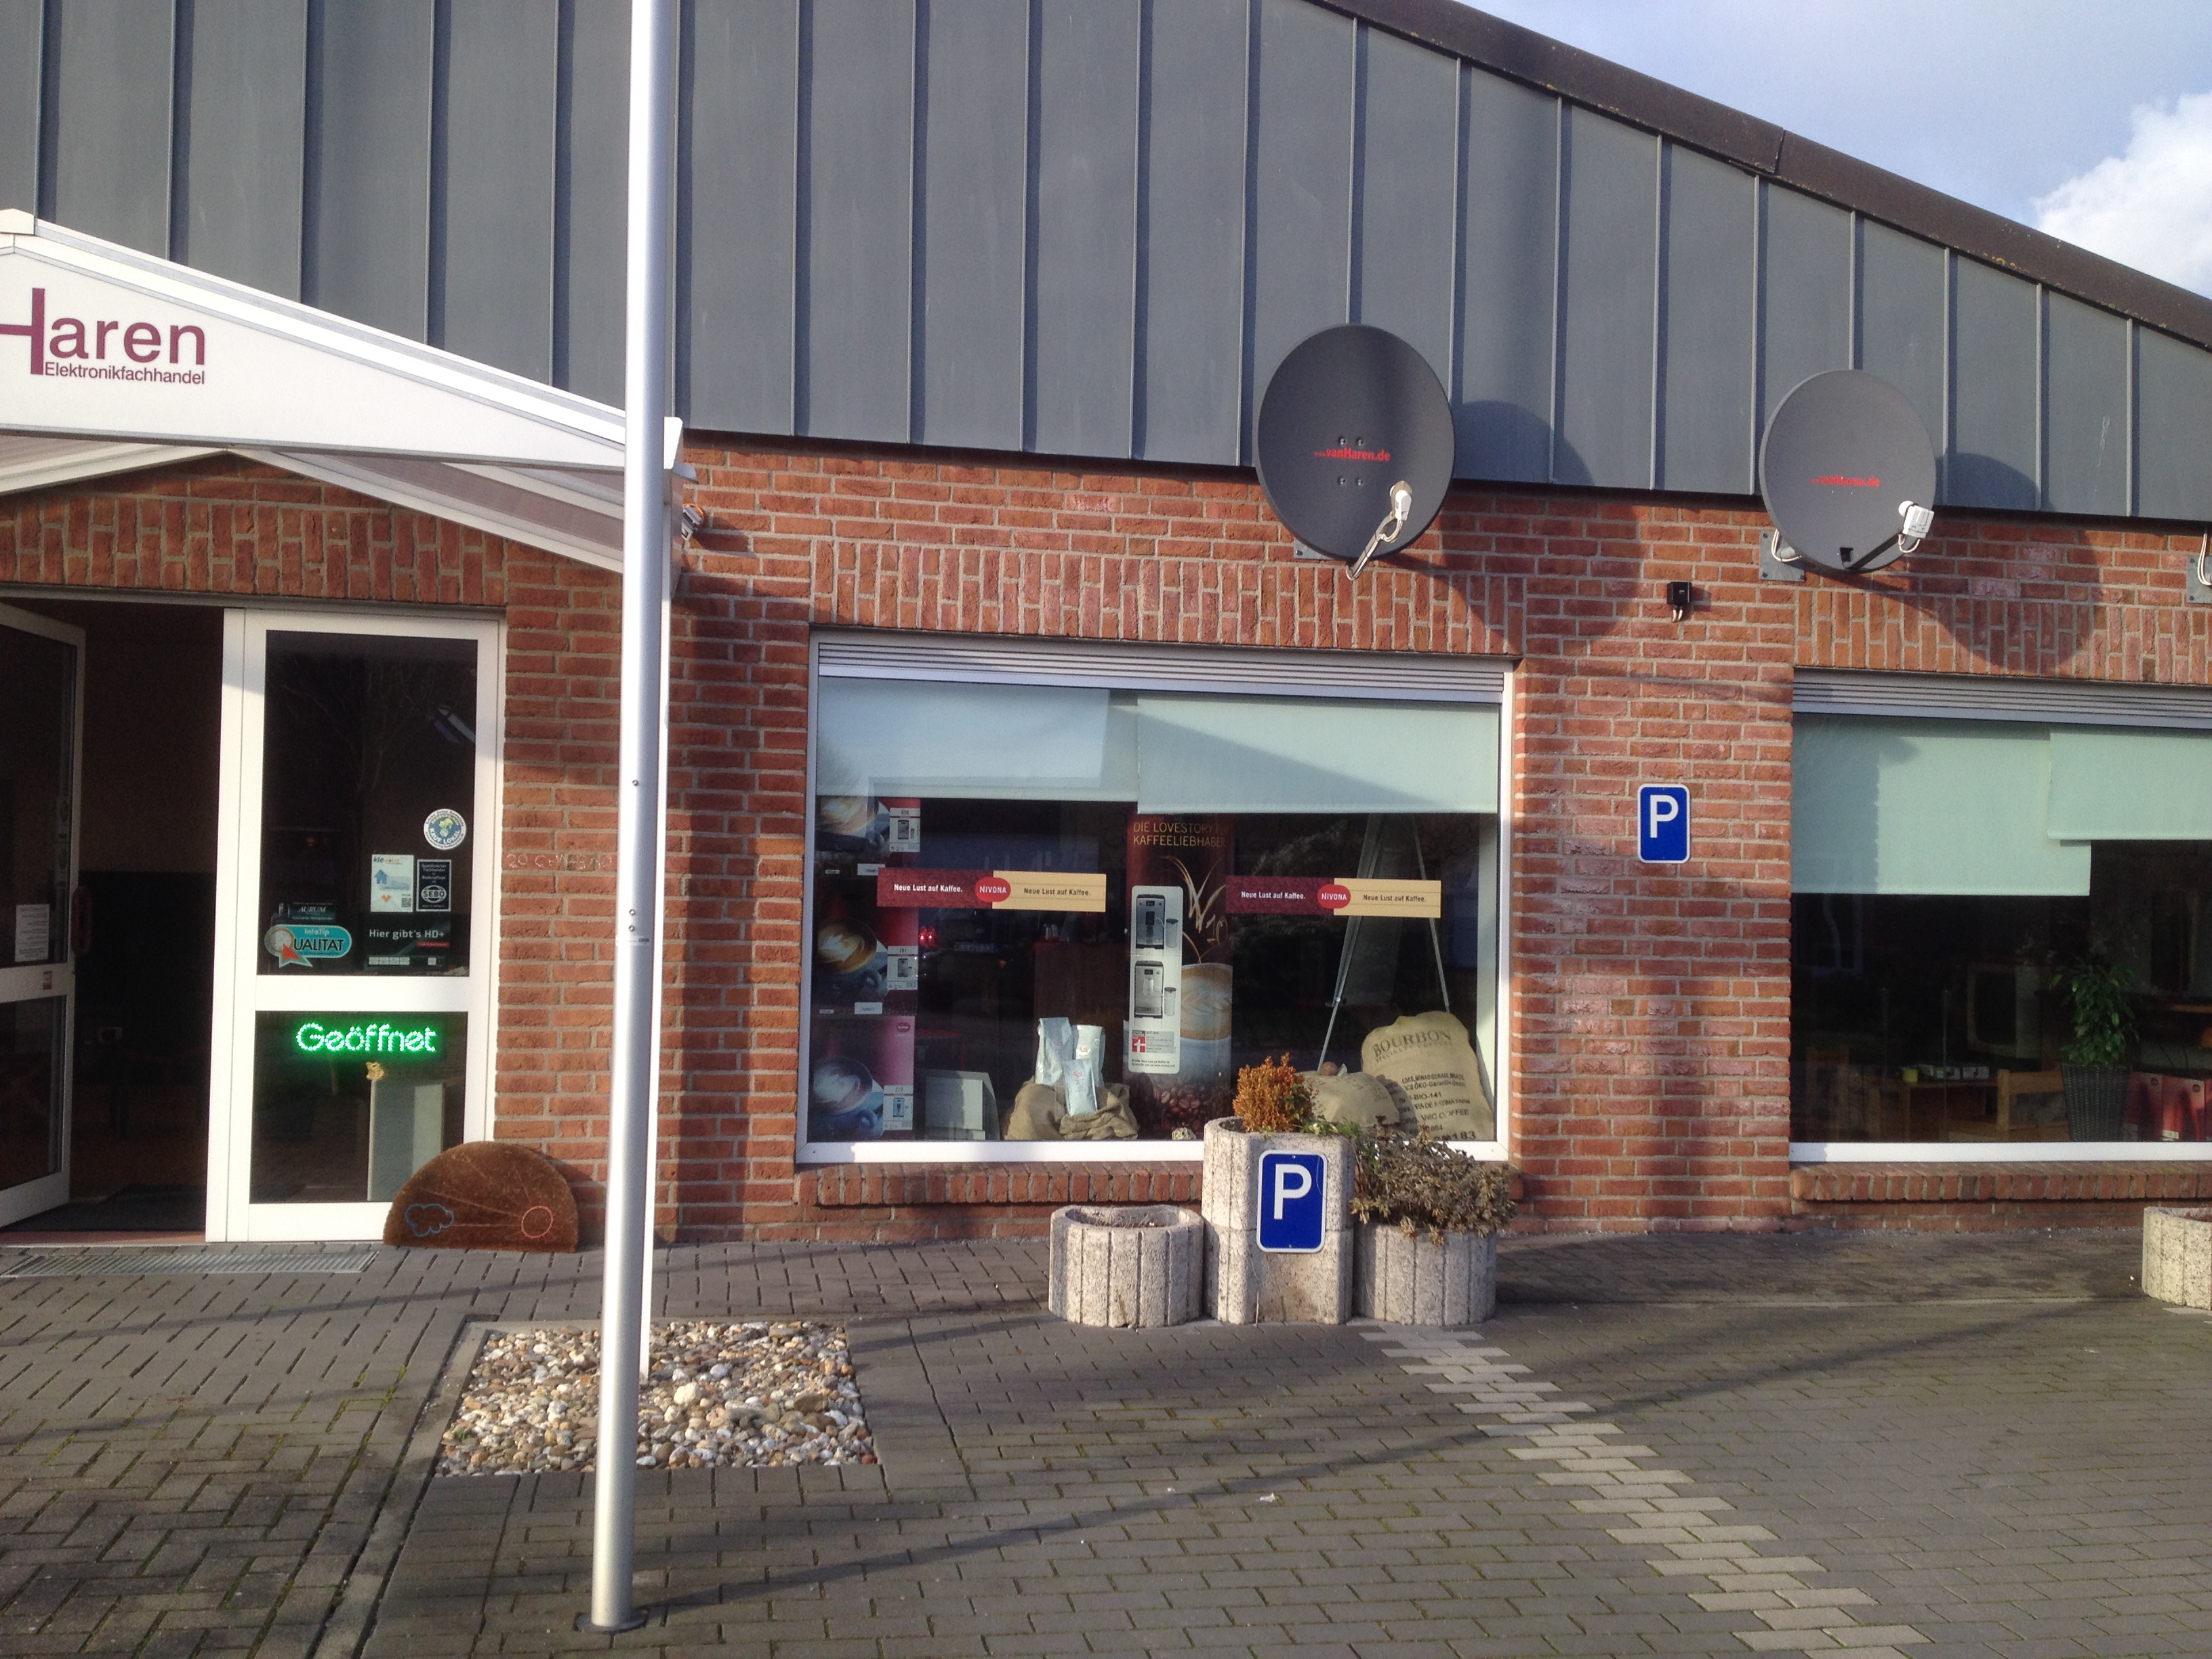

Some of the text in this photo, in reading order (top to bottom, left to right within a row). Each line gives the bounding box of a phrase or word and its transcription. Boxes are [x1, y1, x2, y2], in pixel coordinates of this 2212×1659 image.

[44, 361, 205, 384] Elektronikfachhandel
[1650, 795, 1679, 838] P
[1134, 822, 1150, 832] DIE
[1153, 822, 1213, 834] LOVESTORY
[429, 827, 443, 842] KAUF
[443, 830, 461, 844] LOKAL
[1133, 835, 1225, 847] KAFFEELIEBHABER
[940, 884, 963, 893] Kaffee.
[979, 886, 1006, 894] NIVONA
[1069, 888, 1091, 897] Kaffee.
[1322, 893, 1347, 901] NIVONA
[369, 929, 445, 940] Hier gibt's HD+
[295, 1022, 436, 1052] Geöffnet
[1373, 1030, 1452, 1057] BOURBON
[1273, 1164, 1312, 1220] P
